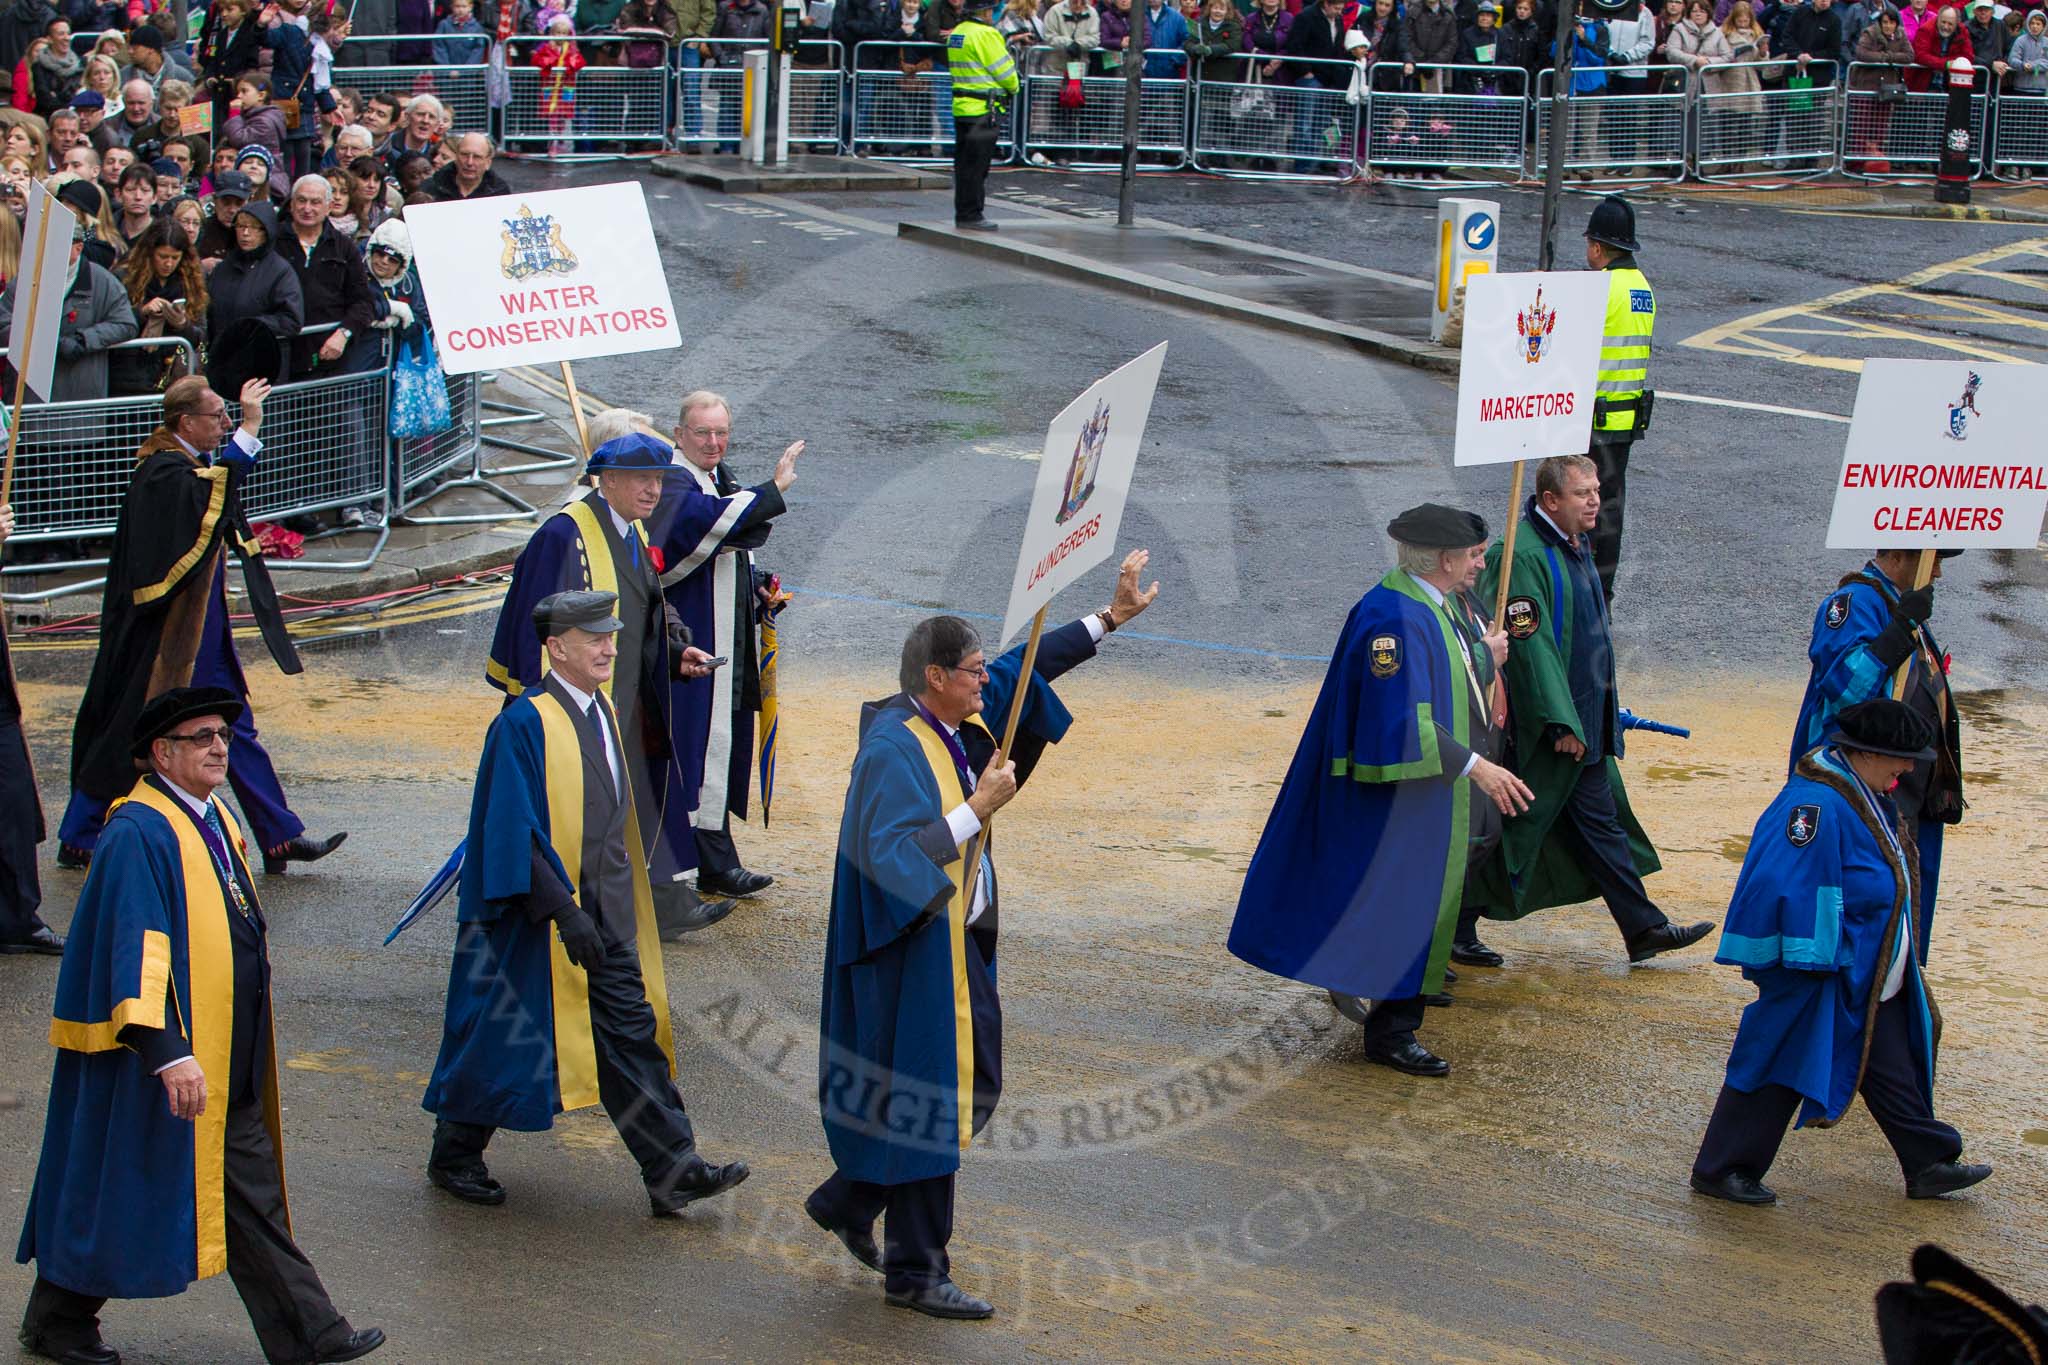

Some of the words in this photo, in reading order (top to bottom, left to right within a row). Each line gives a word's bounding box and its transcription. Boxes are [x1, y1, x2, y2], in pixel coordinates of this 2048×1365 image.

[500, 285, 599, 314] WATER
[1631, 297, 1653, 311] POLICE
[448, 307, 668, 352] CONSERVATORS
[1480, 392, 1575, 422] MARKETORS
[1843, 463, 2048, 490] ENVIRONMENTAL
[1873, 506, 2004, 531] CLEANERS
[1027, 513, 1102, 591] LAUNDERERS
